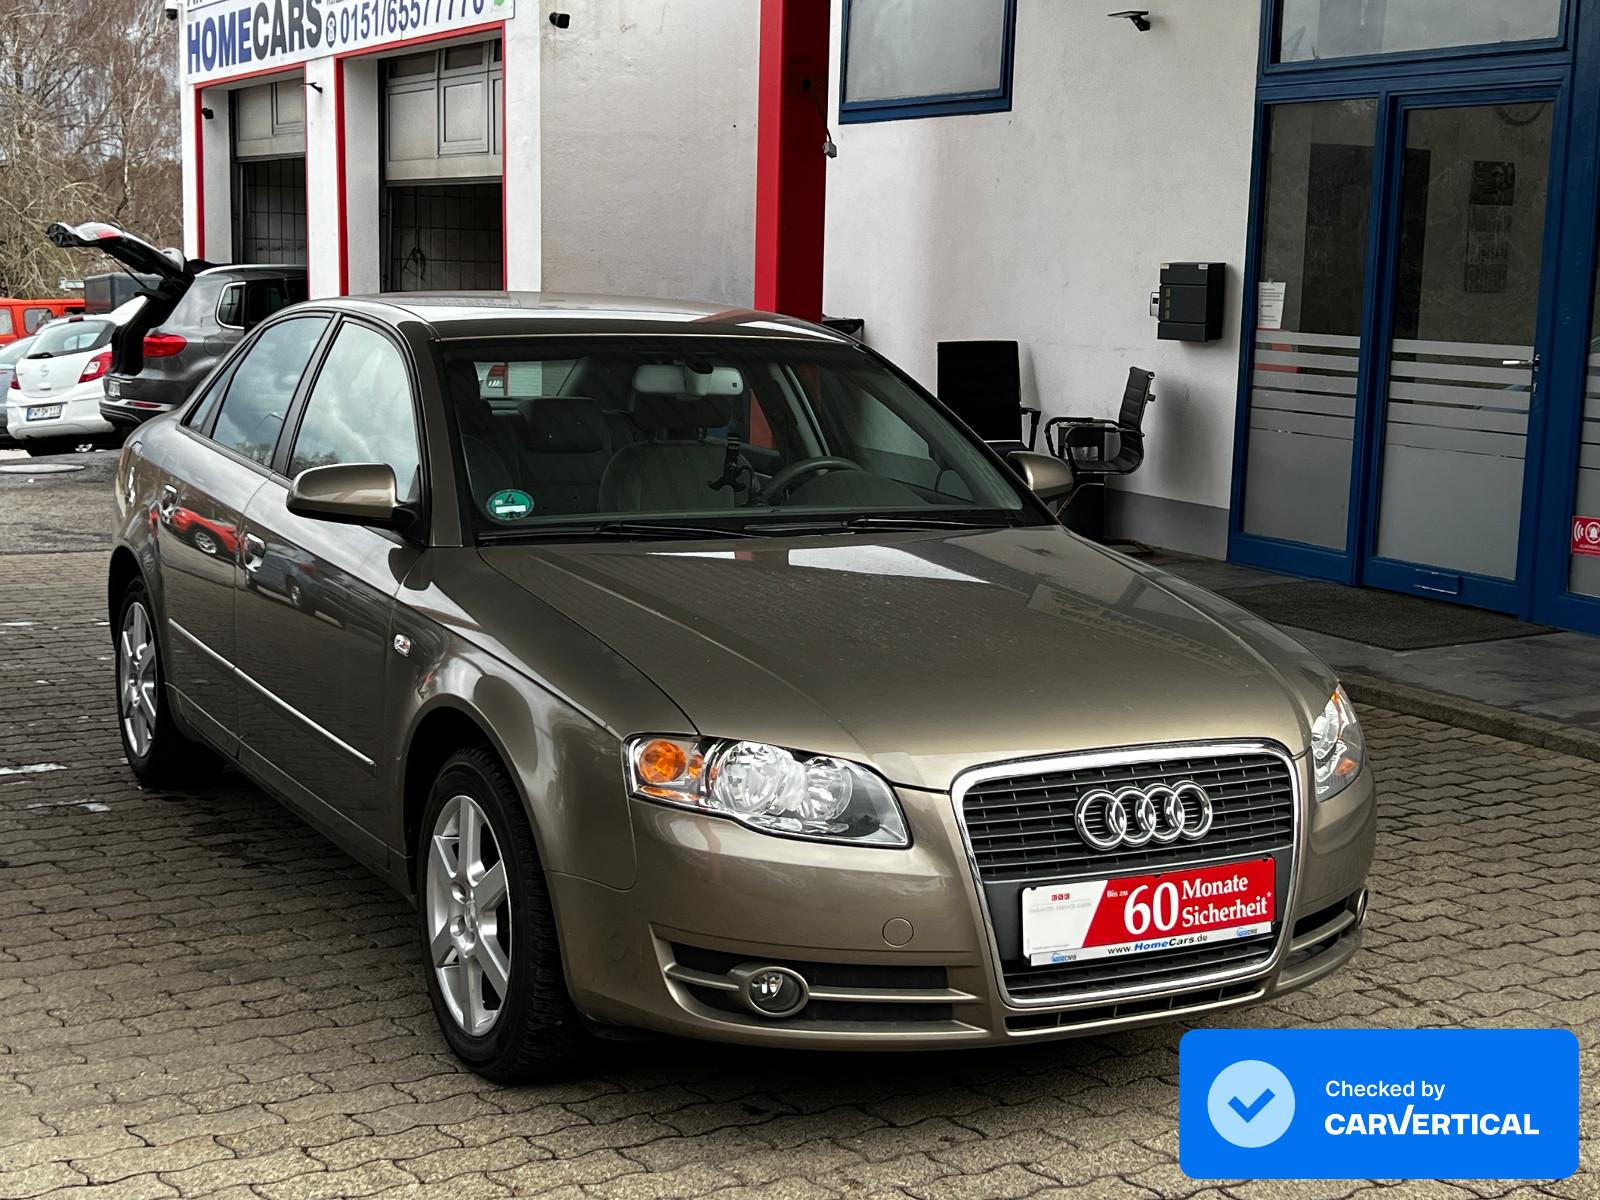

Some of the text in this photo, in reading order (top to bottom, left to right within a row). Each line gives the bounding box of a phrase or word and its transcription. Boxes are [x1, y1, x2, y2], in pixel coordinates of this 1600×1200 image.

[187, 0, 323, 74] HOMECARS
[504, 493, 516, 505] 4
[1123, 881, 1180, 936] 60
[1181, 873, 1249, 900] Monate
